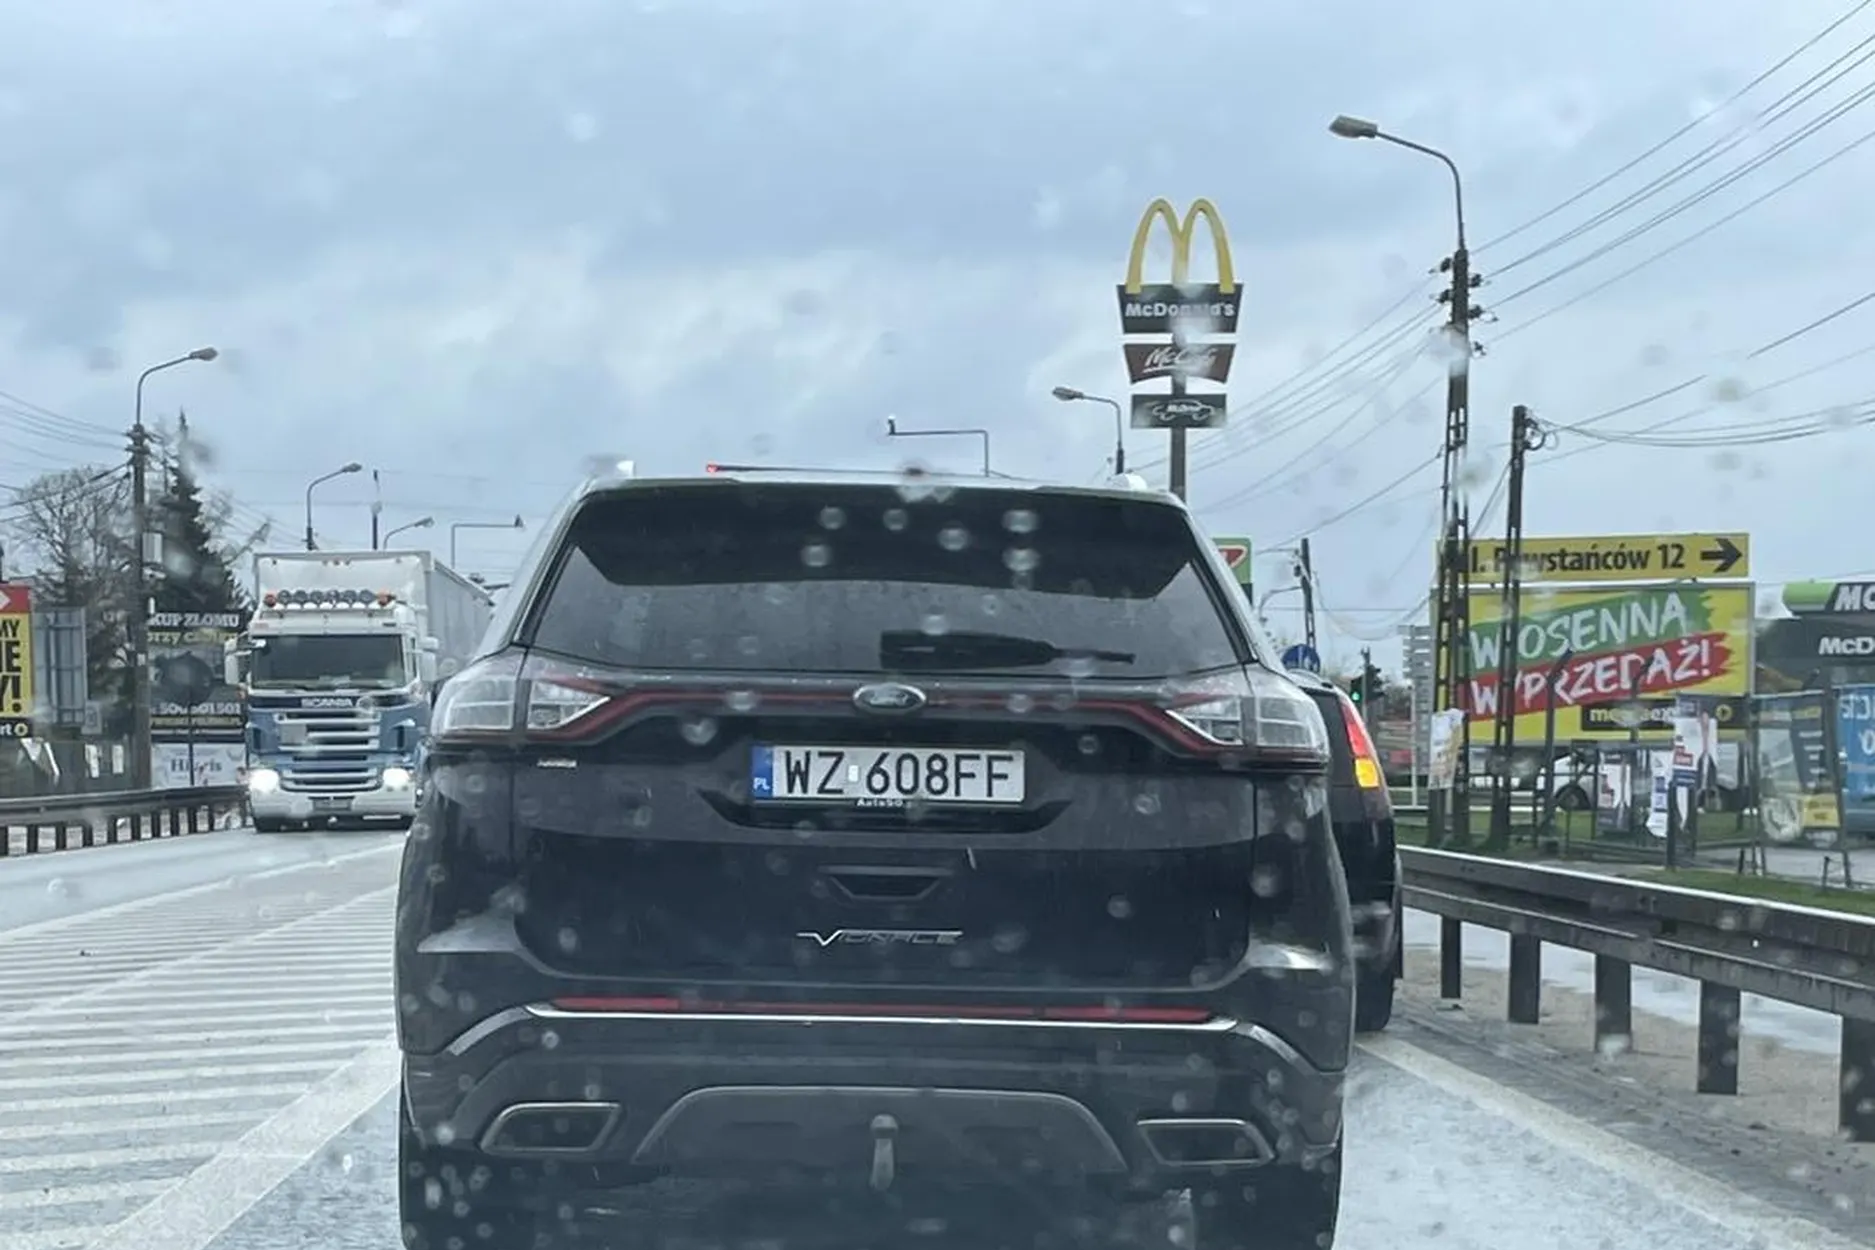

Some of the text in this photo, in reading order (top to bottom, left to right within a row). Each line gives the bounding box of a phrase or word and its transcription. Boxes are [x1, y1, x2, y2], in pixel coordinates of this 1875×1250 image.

[1125, 303, 1236, 317] McDond's
[1494, 544, 1651, 572] Pwstańców
[1657, 544, 1686, 569] 12
[1470, 592, 1689, 669] WOSENNA
[1819, 636, 1875, 655] McD
[753, 776, 770, 790] PL
[784, 750, 1014, 797] WZ 608FF
